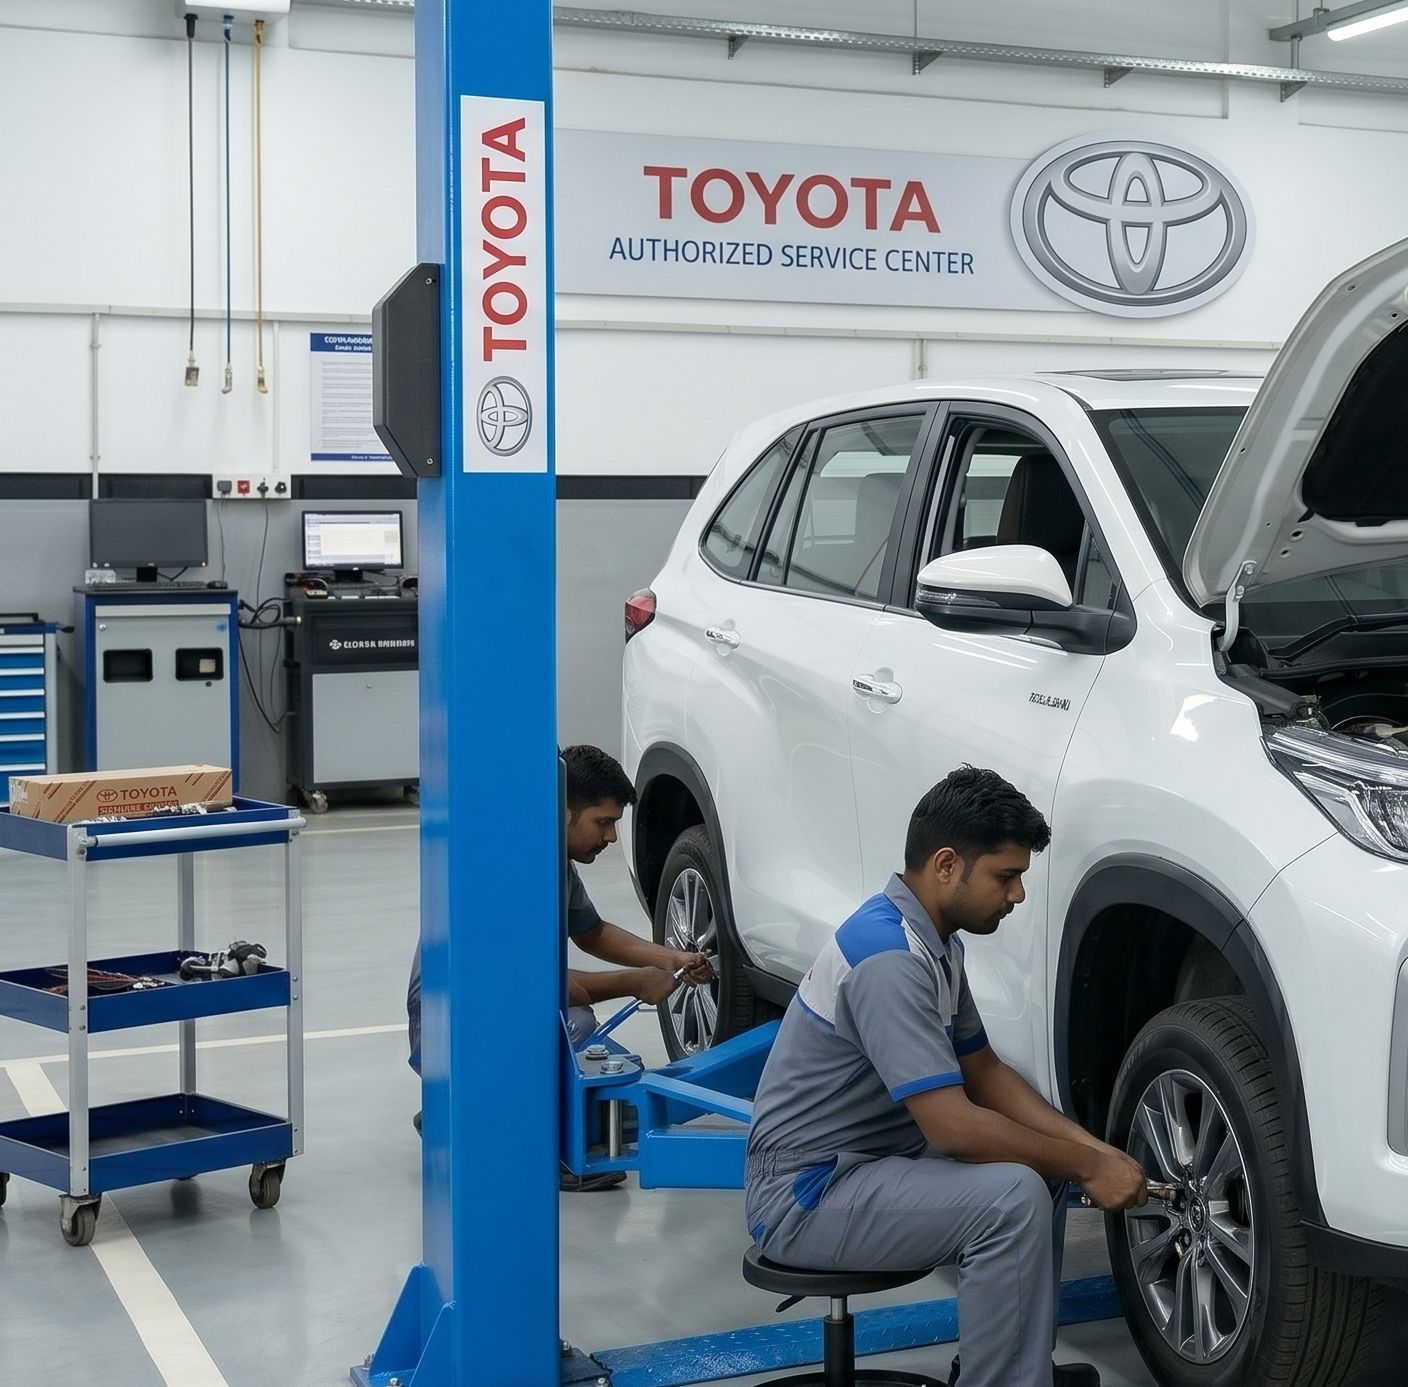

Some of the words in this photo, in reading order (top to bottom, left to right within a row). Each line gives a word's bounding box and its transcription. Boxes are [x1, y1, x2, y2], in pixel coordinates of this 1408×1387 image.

[643, 165, 941, 234] TOYOTA
[481, 117, 528, 362] TOYOTA
[609, 237, 773, 266] AUTHORIZED
[780, 244, 877, 271] SERVICE
[885, 249, 974, 274] CENTER
[120, 786, 178, 800] TOYOTA
